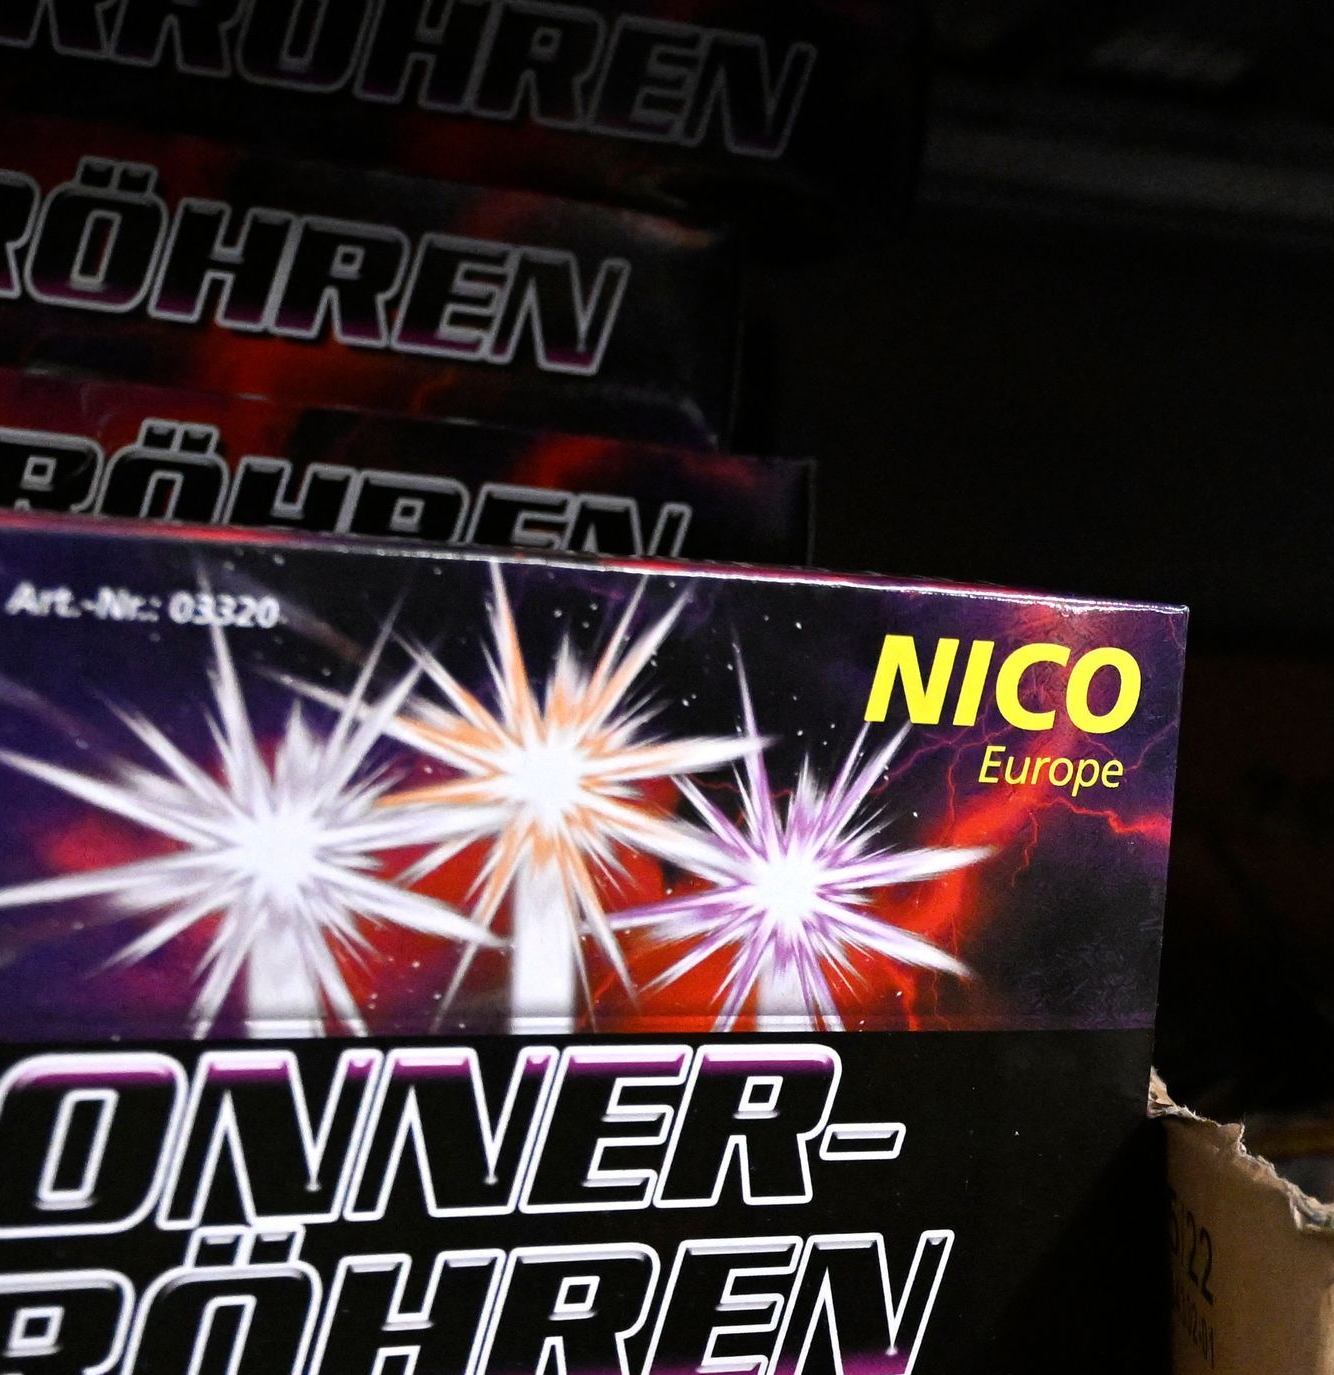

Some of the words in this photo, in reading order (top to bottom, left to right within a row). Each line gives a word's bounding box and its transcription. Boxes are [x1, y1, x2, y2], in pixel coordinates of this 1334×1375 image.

[169, 590, 281, 629] 03320
[864, 634, 1142, 734] NICO
[978, 745, 1124, 797] Europe
